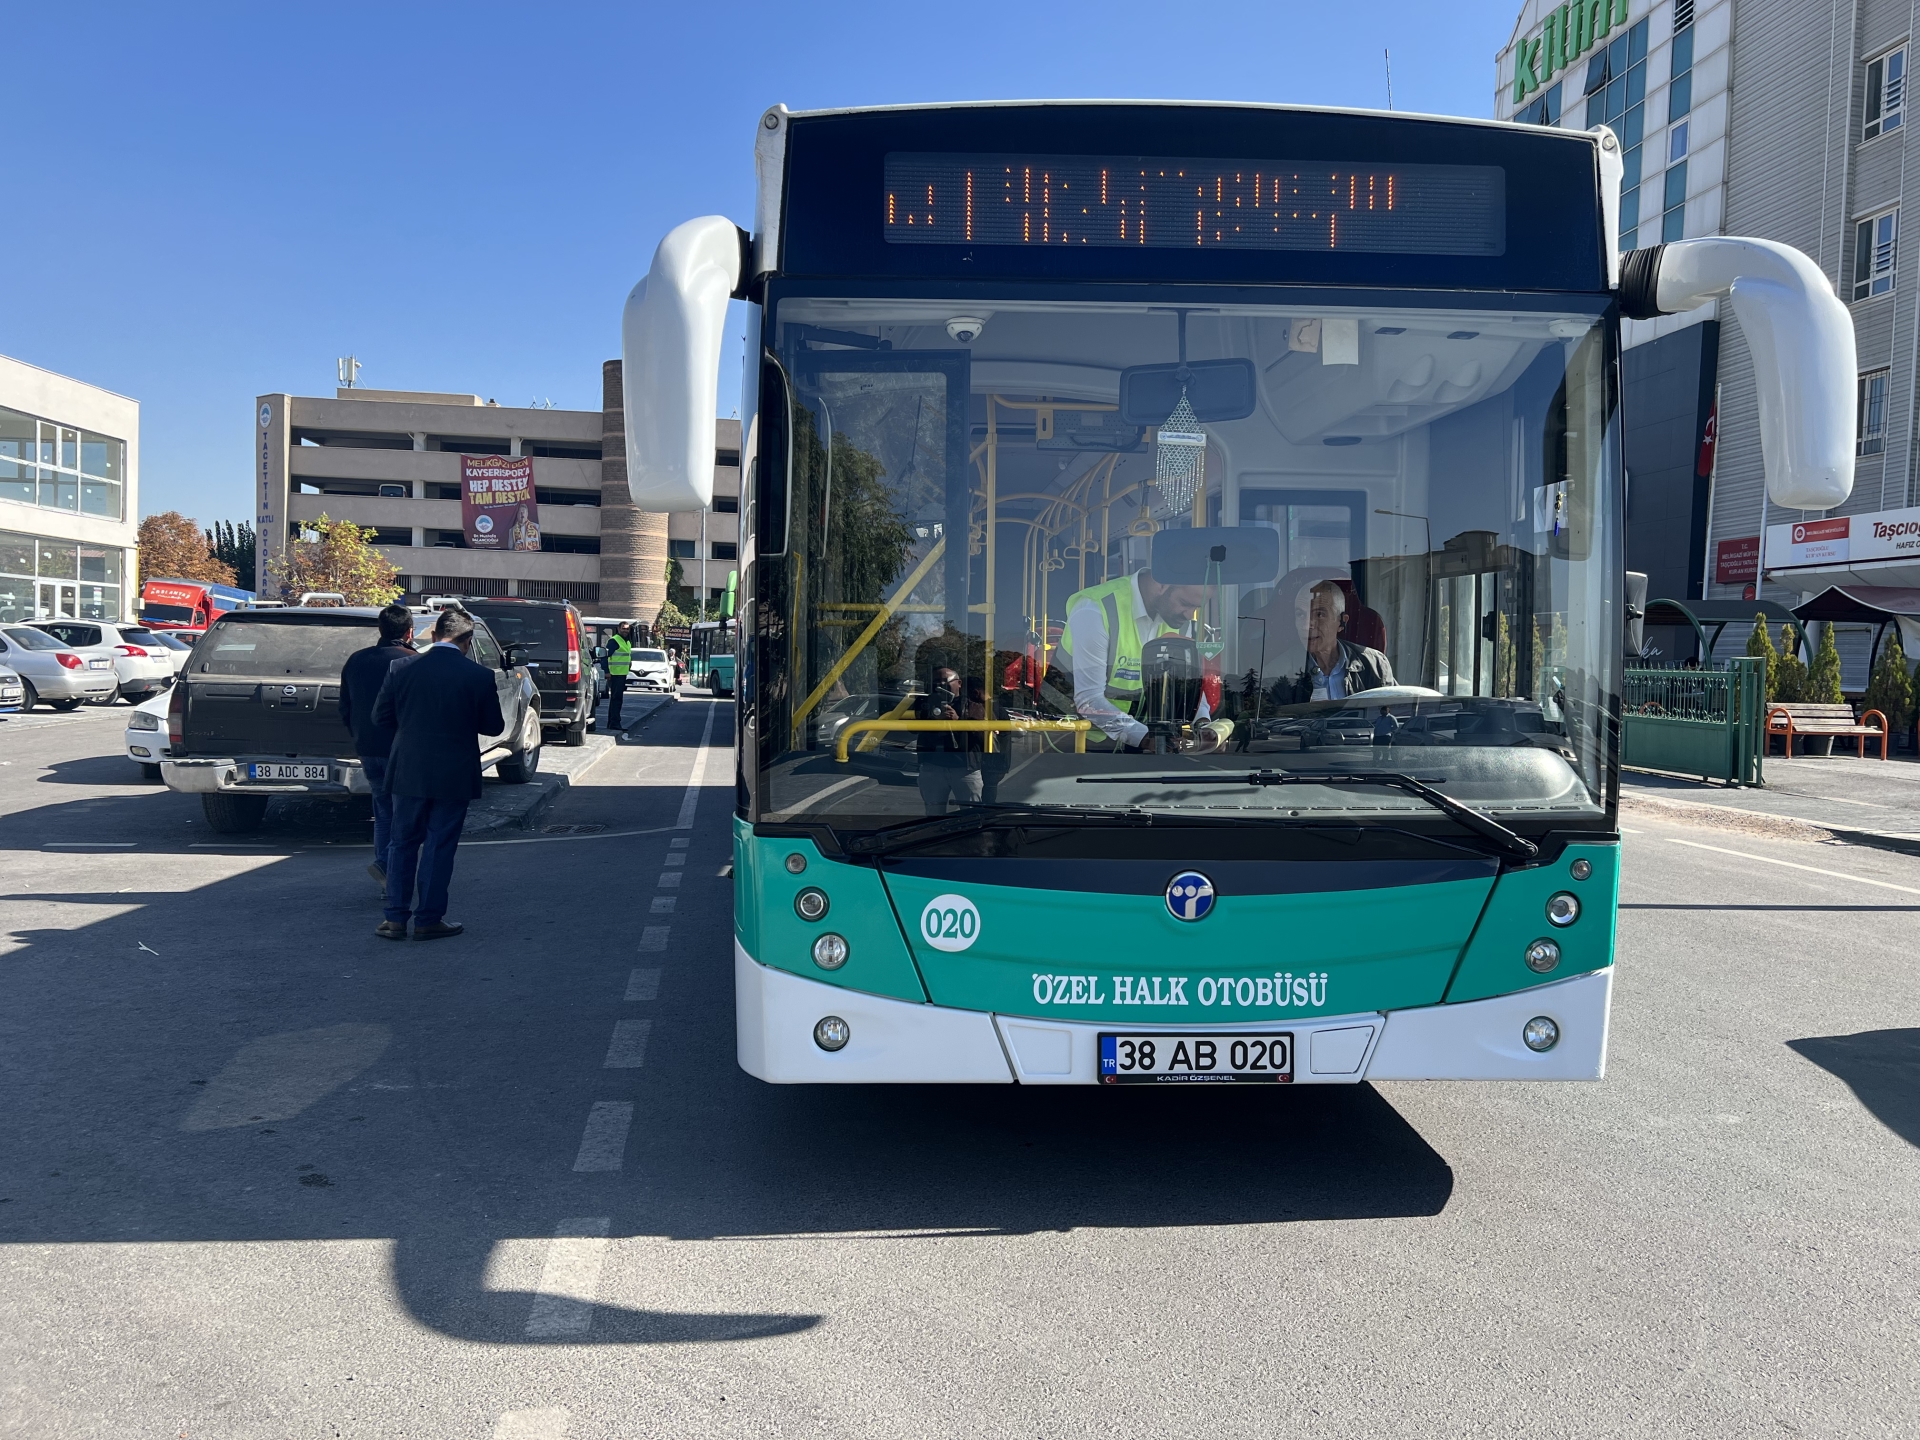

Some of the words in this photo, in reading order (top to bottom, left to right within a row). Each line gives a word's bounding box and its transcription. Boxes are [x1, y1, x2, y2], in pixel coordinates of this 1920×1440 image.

[469, 479, 489, 492] HEP
[491, 476, 528, 492] DESTEK
[468, 491, 493, 505] TAM
[495, 488, 531, 504] DESTEK
[257, 515, 274, 523] KATLI
[257, 765, 271, 778] 38
[277, 765, 299, 778] ADC
[304, 766, 325, 779] 884
[925, 907, 976, 939] 020
[1032, 973, 1105, 1005] ÖZEL
[1112, 976, 1189, 1006] HALK
[1197, 972, 1328, 1007] OTOBÜSÜ
[1103, 1059, 1115, 1068] TR
[1118, 1040, 1156, 1071] 38
[1168, 1040, 1217, 1071] AB
[1230, 1040, 1287, 1071] 020
